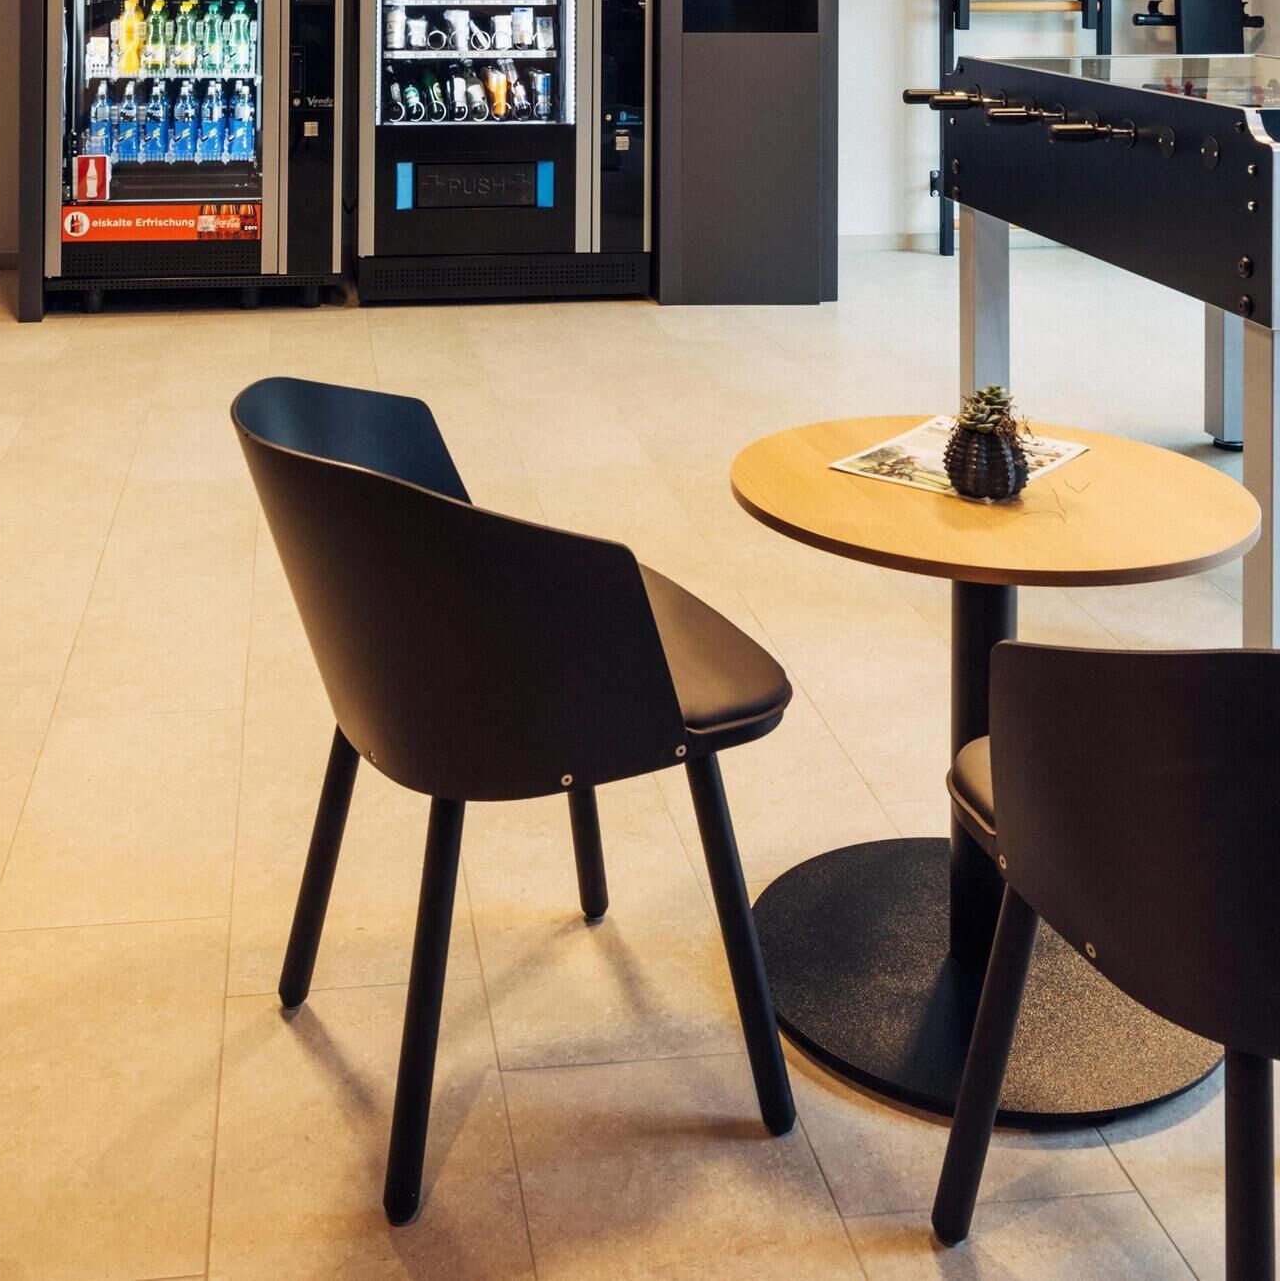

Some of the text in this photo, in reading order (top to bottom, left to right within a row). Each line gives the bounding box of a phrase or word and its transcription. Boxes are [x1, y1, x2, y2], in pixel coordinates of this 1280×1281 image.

[448, 177, 505, 195] PUSH
[91, 217, 195, 229] eiskalte Erfrischung
